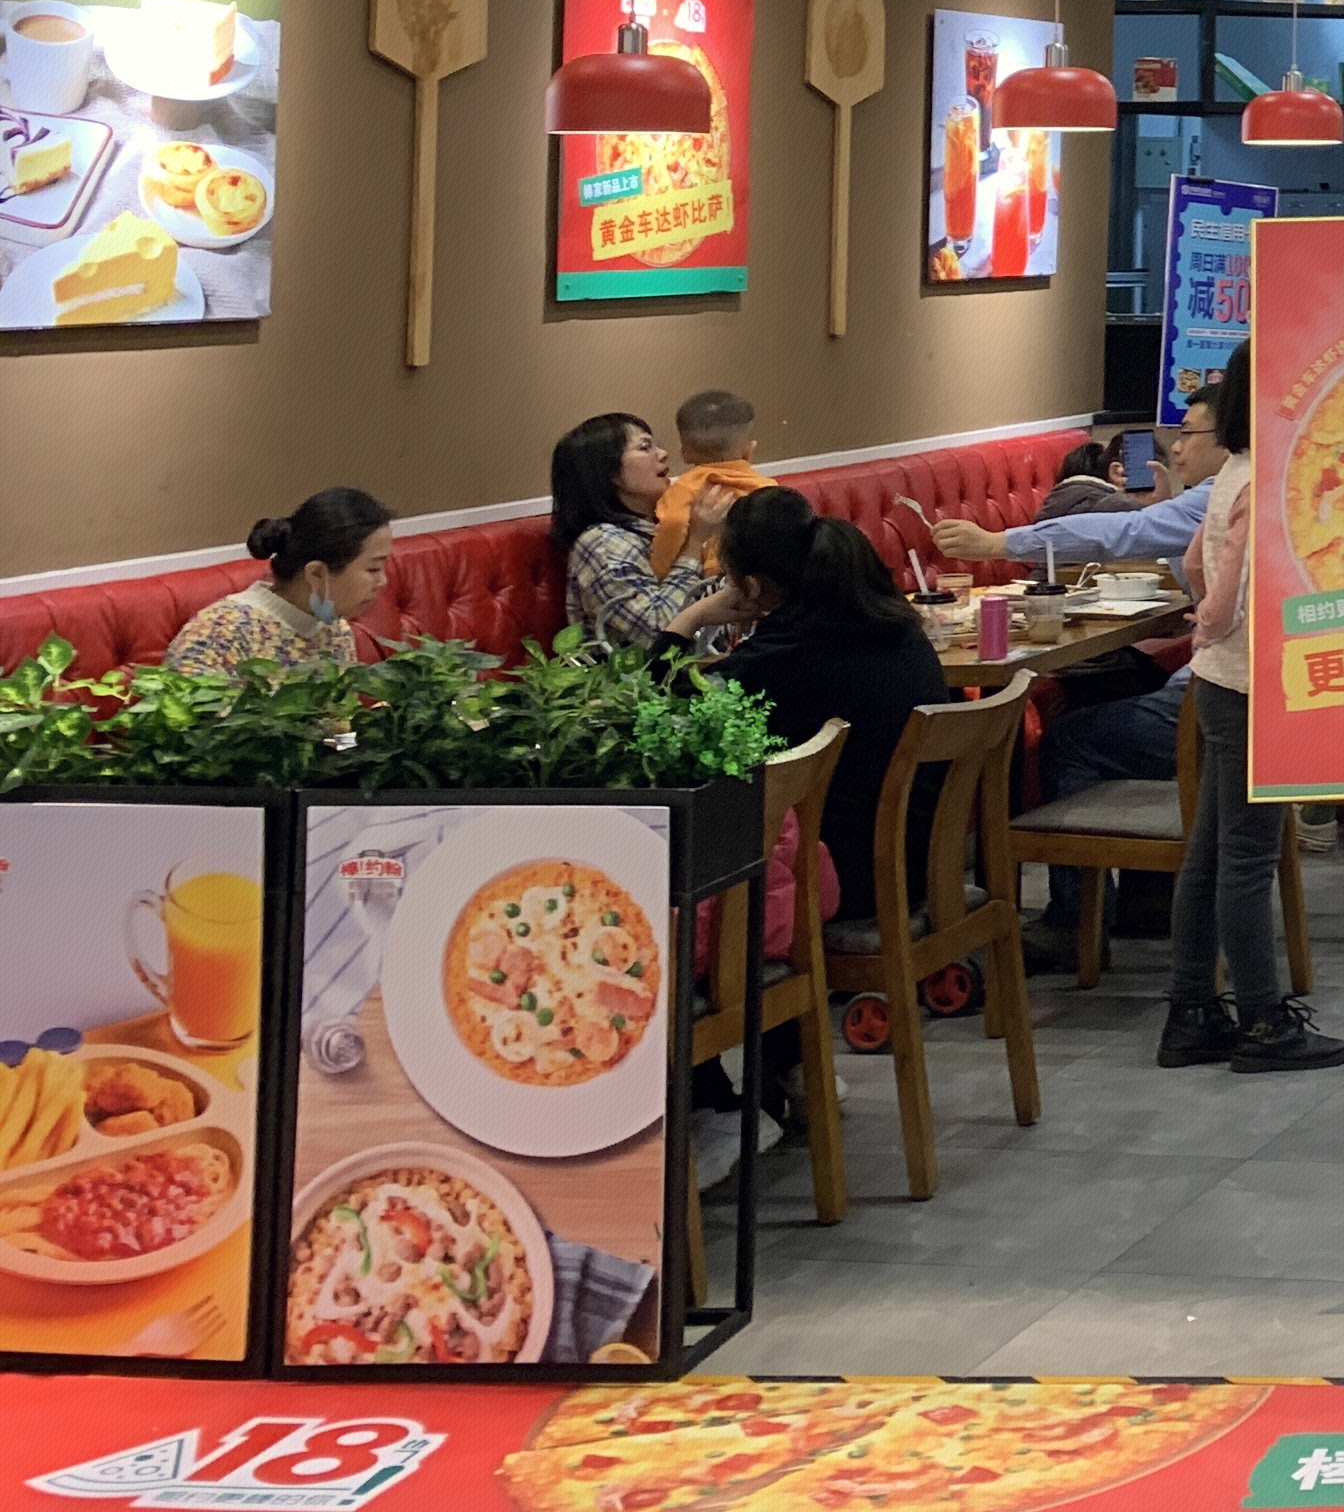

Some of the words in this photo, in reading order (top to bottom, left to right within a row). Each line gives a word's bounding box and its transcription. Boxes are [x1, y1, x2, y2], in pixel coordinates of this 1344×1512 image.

[599, 192, 731, 249] 黄金车达虾比萨!
[183, 1422, 411, 1485] 18
